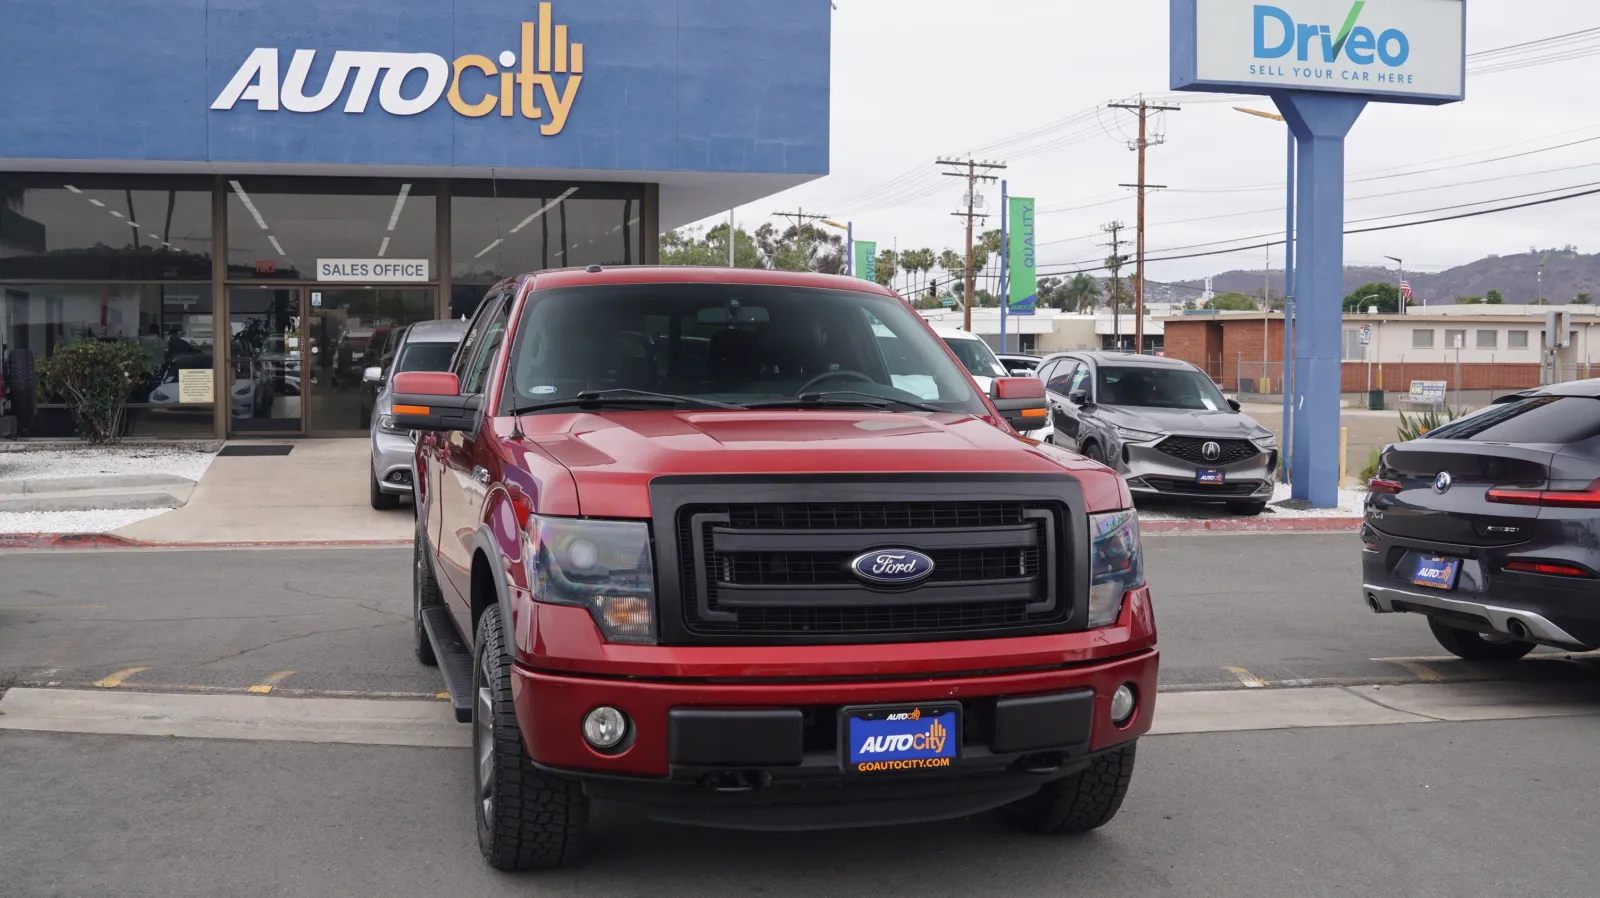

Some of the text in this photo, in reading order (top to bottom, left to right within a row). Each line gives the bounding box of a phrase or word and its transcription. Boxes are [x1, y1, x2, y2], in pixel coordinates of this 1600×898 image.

[1253, 1, 1410, 67] Driveo
[1249, 65, 1413, 84] SELL YOUR CAR HERE
[322, 263, 424, 277] SALES OFFICE
[865, 244, 876, 282] RVICE.
[872, 554, 917, 577] Ford
[858, 758, 950, 772] GOAUTOCITY.COM
